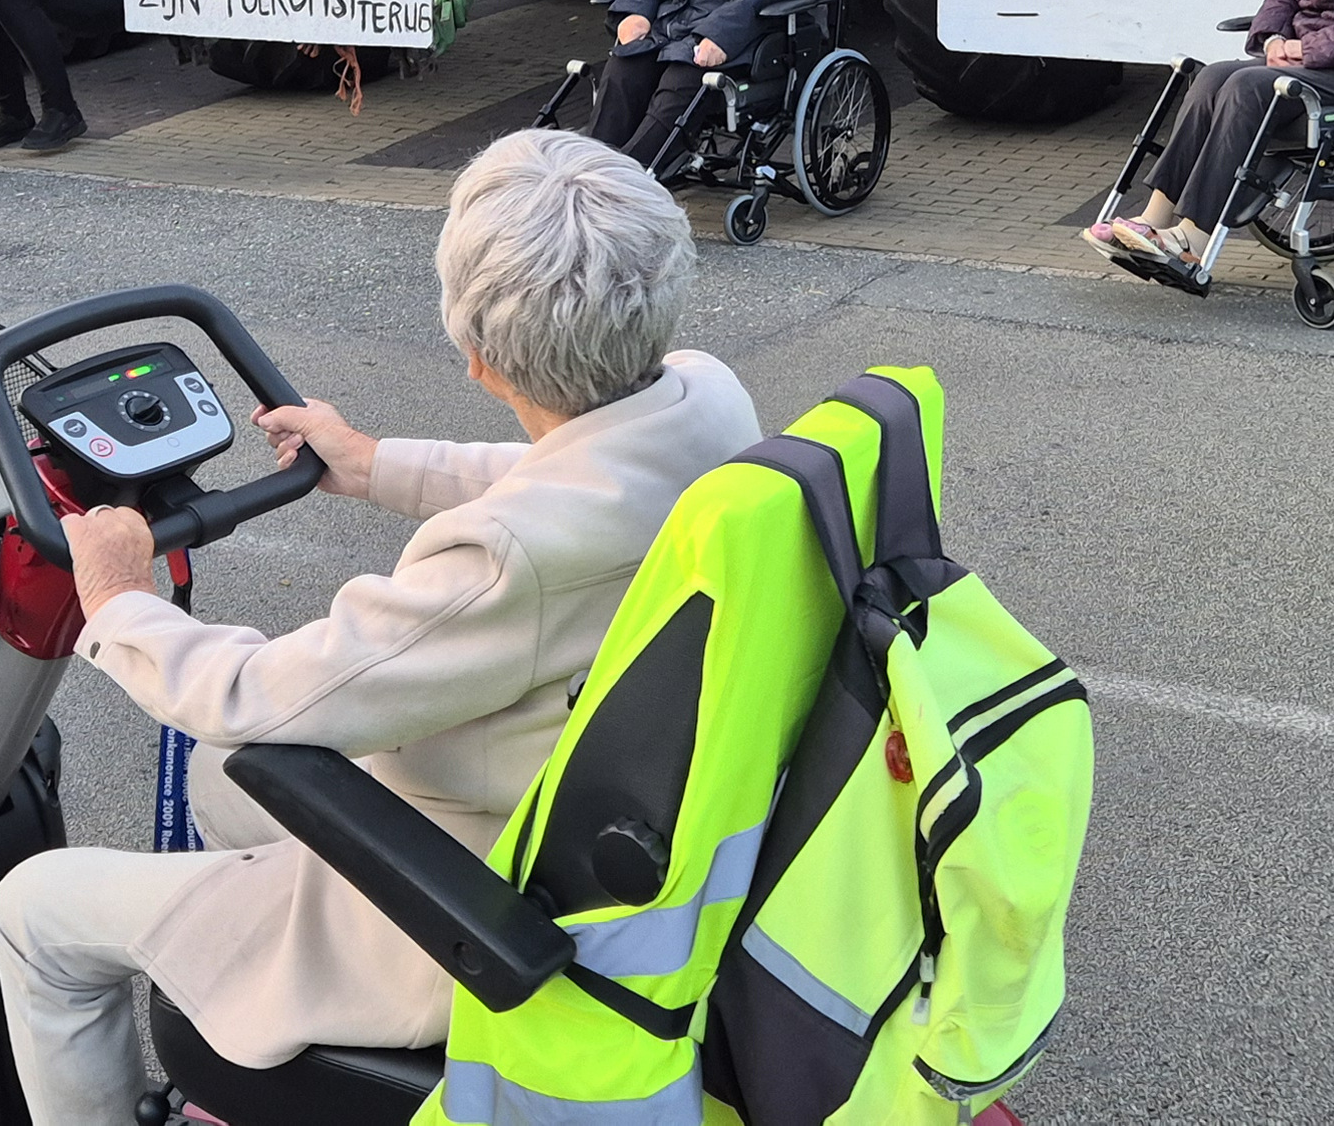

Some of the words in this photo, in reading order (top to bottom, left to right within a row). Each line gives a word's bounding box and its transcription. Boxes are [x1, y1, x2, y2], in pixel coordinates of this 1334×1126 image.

[358, 0, 432, 33] TERUG
[163, 728, 178, 796] onkanorace
[161, 799, 174, 827] 2009
[161, 829, 173, 852] Roe
